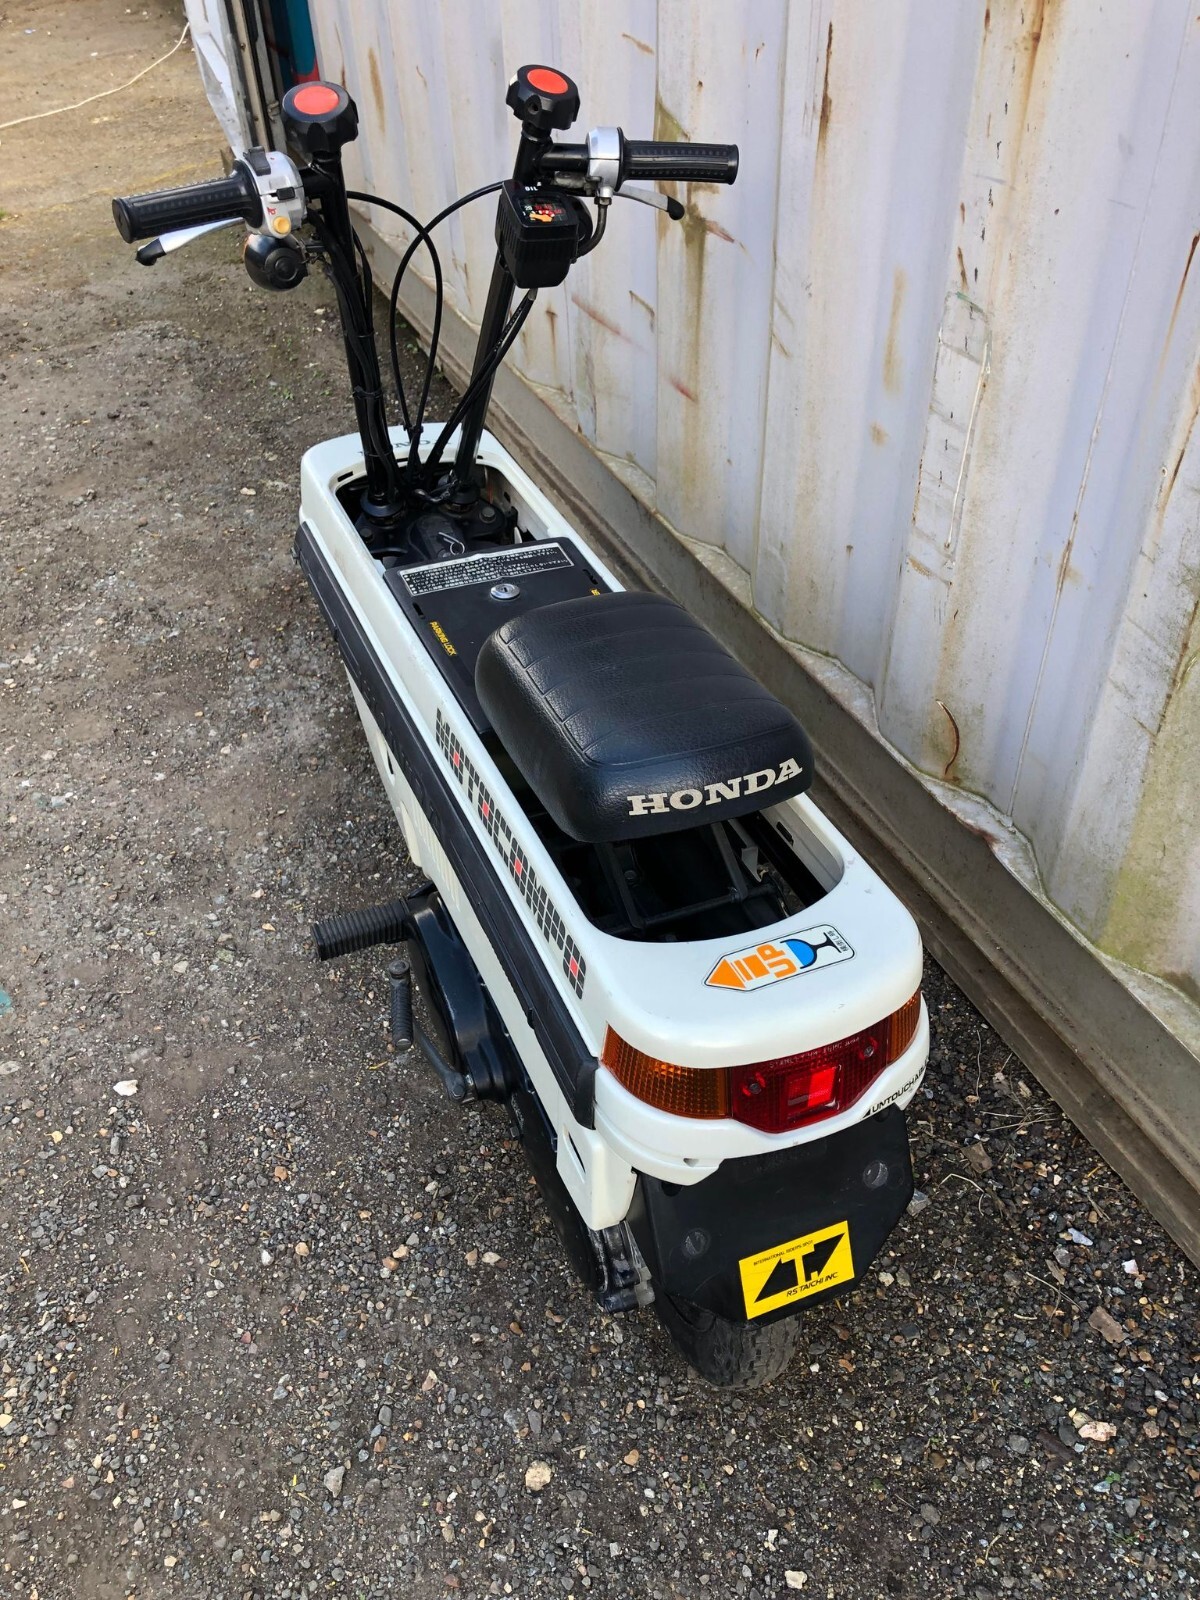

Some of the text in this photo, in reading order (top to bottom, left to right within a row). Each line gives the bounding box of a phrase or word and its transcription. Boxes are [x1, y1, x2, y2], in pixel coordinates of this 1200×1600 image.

[428, 620, 457, 657] PARKING LOCK
[626, 757, 803, 816] HONDA
[435, 707, 587, 1000] MOTOCOMPO
[756, 944, 798, 979] UP
[753, 1250, 785, 1266] INTERNATIONAL
[786, 1271, 839, 1298] RS TAICHI INC
